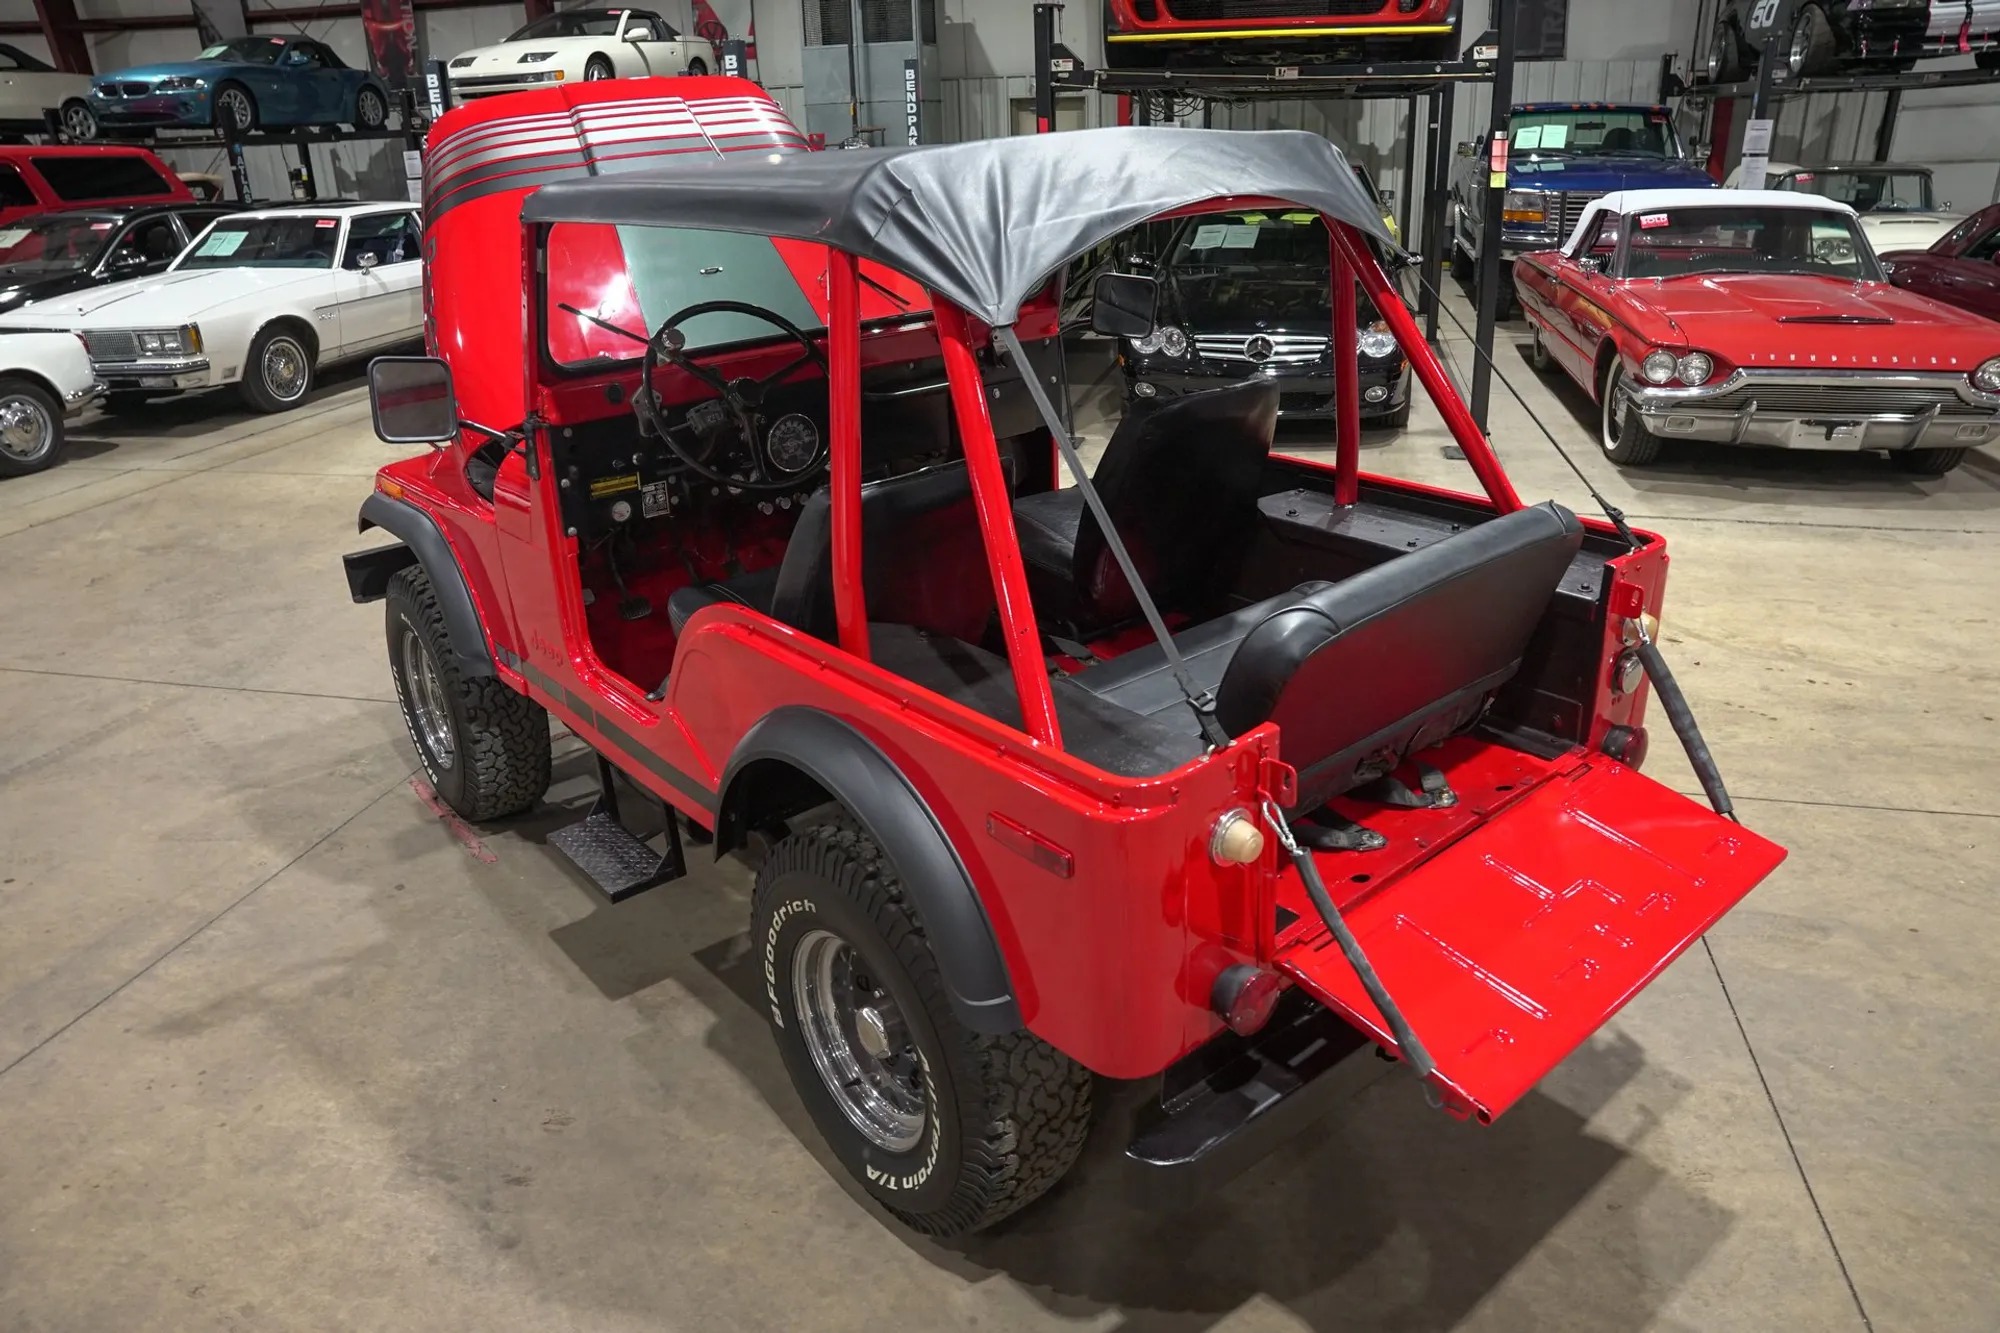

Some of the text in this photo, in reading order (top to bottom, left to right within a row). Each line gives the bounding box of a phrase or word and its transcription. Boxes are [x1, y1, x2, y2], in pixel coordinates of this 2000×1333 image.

[1750, 0, 1780, 29] 50
[905, 69, 918, 146] BENDPAK
[237, 155, 252, 204] ATLAS
[1642, 214, 1668, 225] SOLD
[765, 899, 816, 1029] BFGoodrich
